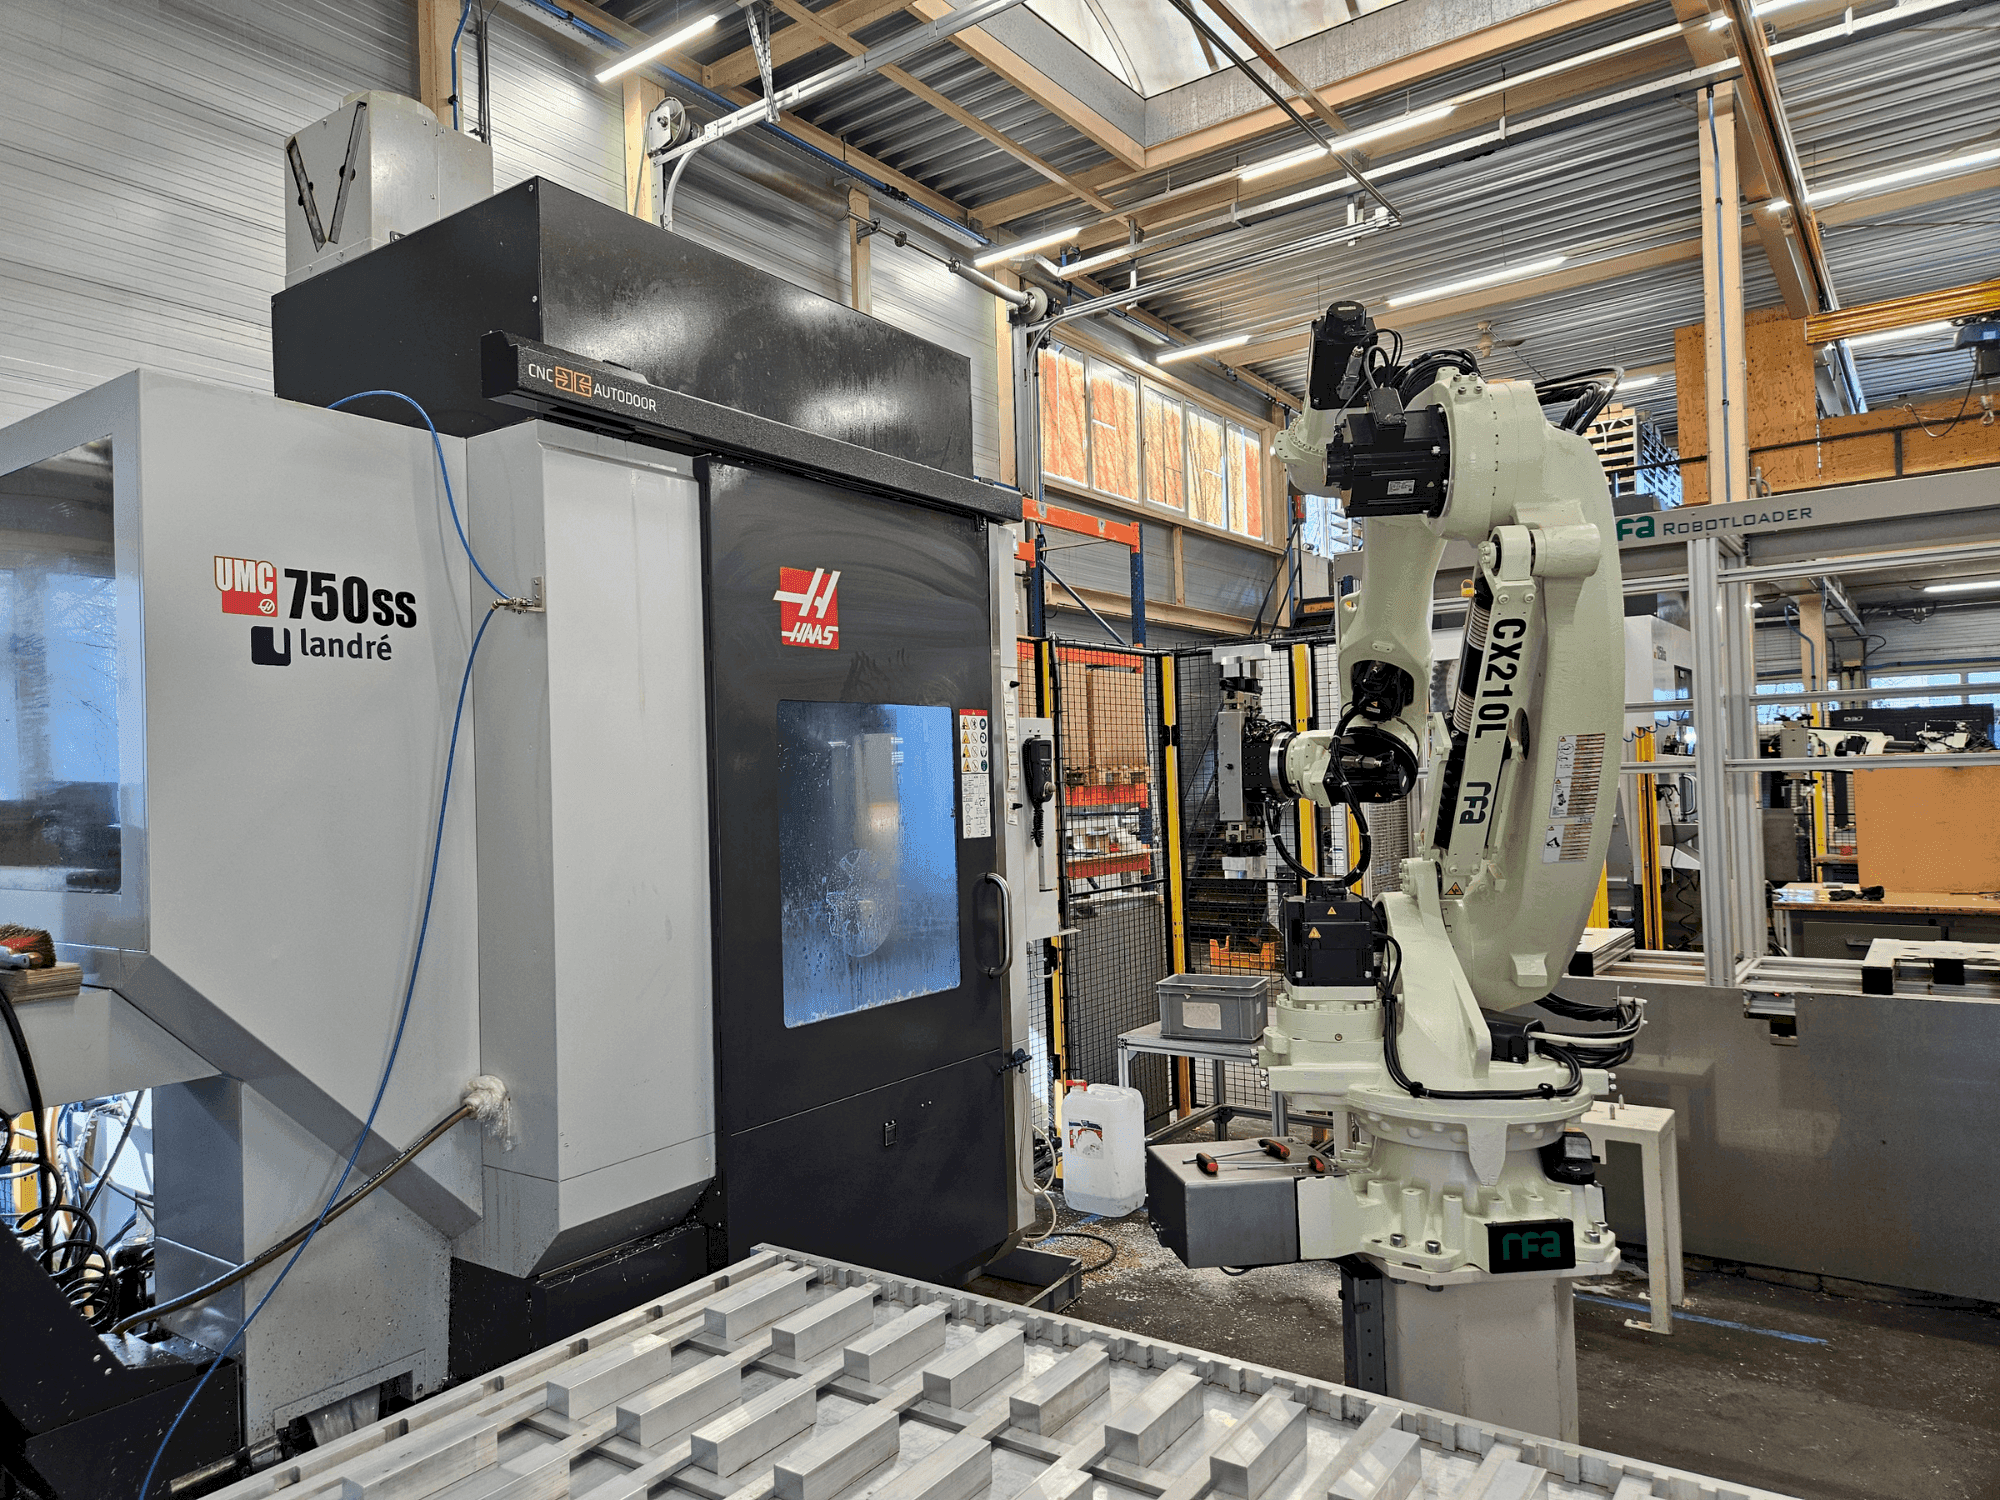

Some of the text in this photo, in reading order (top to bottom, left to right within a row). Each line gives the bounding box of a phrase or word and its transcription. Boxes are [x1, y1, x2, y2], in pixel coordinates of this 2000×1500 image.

[528, 363, 657, 412] CNC AUTODOOR
[1615, 507, 1812, 541] fa ROBOTLOADER
[214, 556, 275, 595] UMC
[300, 628, 393, 661] landré
[781, 621, 839, 646] HAAS
[1475, 618, 1527, 739] CX210L
